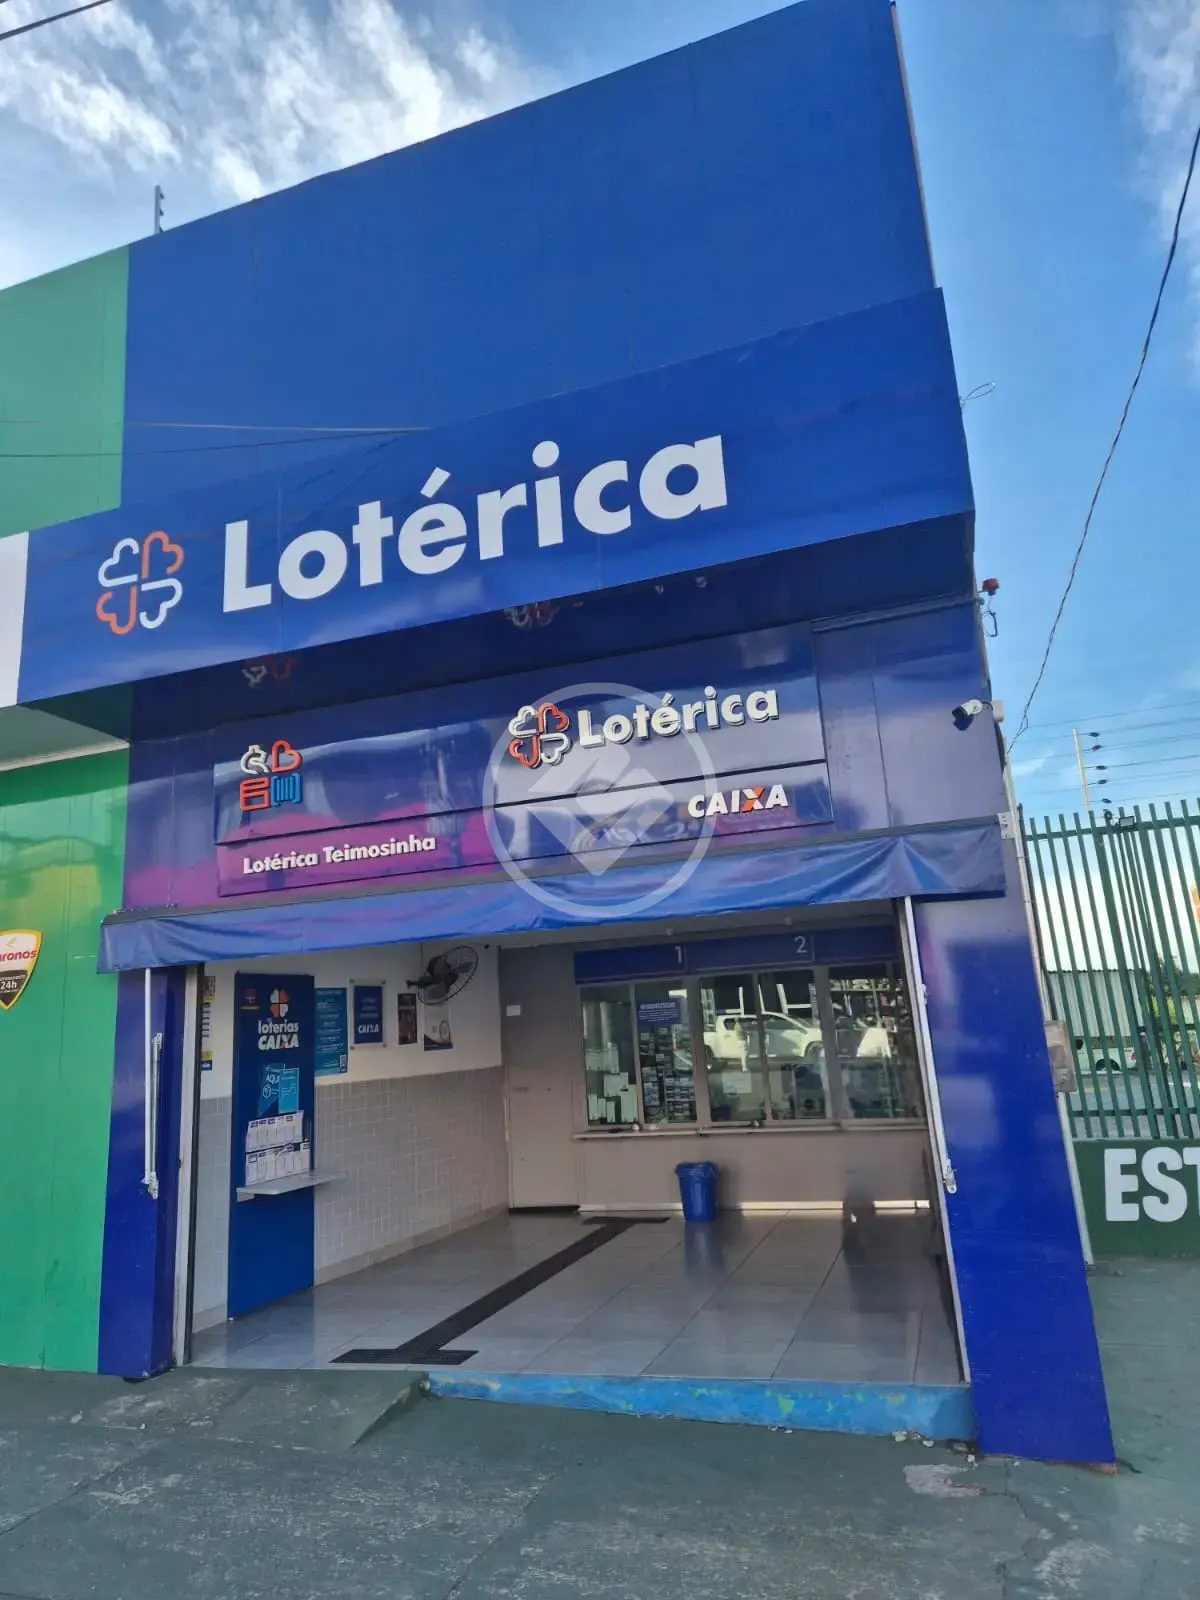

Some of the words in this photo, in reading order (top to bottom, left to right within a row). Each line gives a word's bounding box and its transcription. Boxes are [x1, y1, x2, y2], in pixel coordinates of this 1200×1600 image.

[222, 435, 728, 613] Lotérica
[577, 686, 780, 748] Lotérica
[687, 784, 789, 818] CAIXA
[243, 851, 319, 874] Lotérica
[322, 834, 436, 864] Teimosinha
[794, 935, 807, 953] 2
[0, 950, 37, 962] ronos
[674, 945, 682, 963] 1
[257, 1019, 299, 1034] loterias
[258, 1033, 299, 1050] CAIXA
